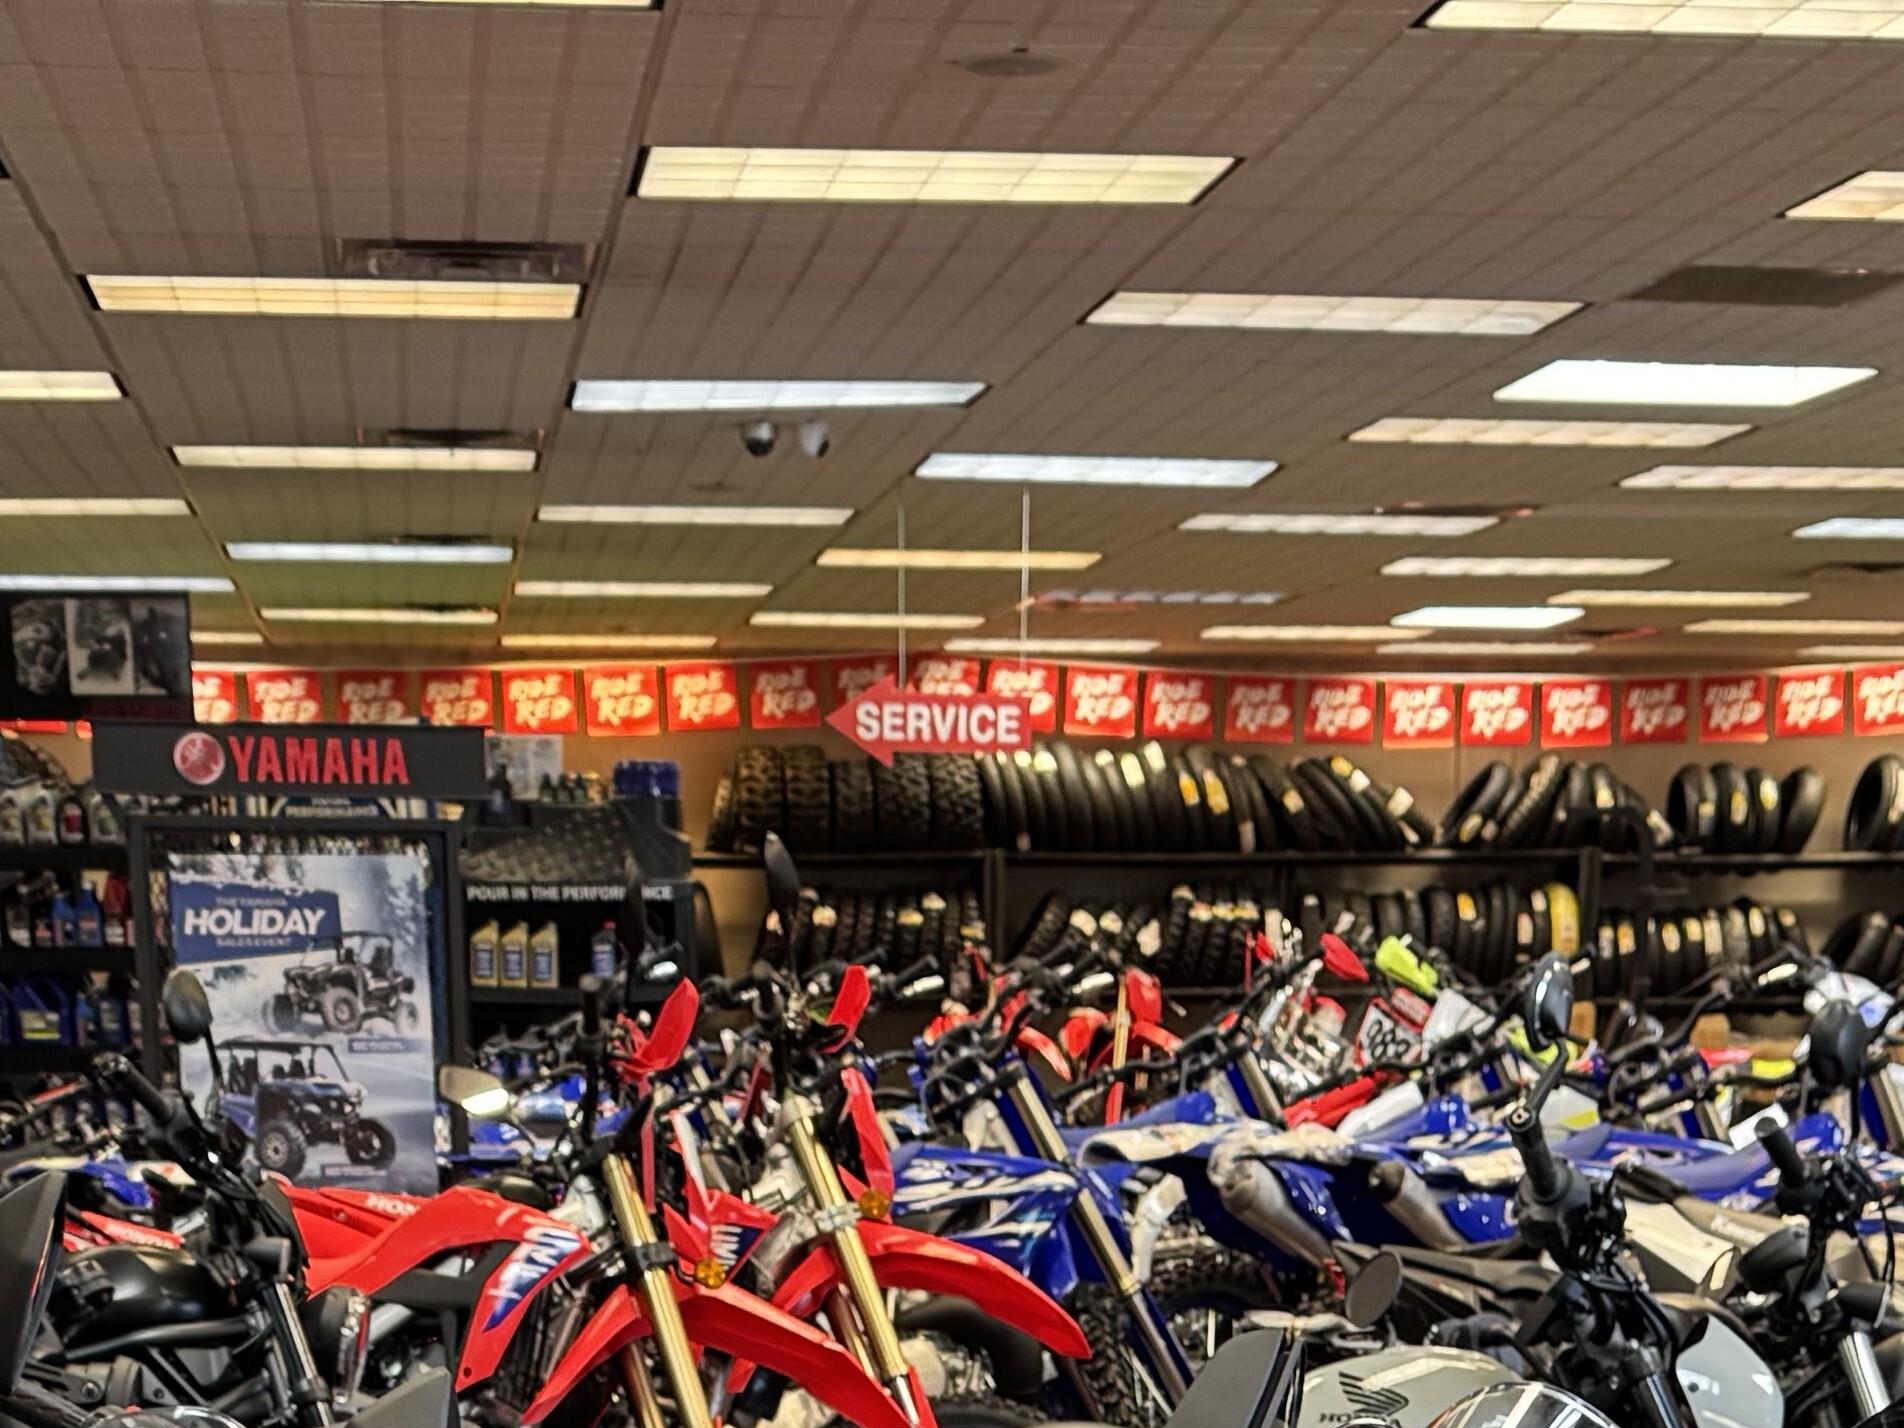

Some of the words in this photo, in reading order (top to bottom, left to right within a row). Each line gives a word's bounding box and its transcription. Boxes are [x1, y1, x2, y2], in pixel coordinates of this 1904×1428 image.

[256, 678, 309, 701] RIDE
[343, 678, 395, 702] RIDE
[426, 676, 480, 702] RIDE
[509, 673, 563, 702] RIDE
[591, 672, 644, 700] RIDE
[673, 669, 725, 697] RIDE
[755, 667, 806, 695] RIDE
[991, 668, 1048, 691] RIDE
[262, 699, 320, 724] RED
[349, 700, 405, 725] RED
[432, 699, 490, 725] RED
[515, 696, 572, 729] RED
[597, 694, 654, 726] RED
[679, 691, 736, 724] RED
[761, 688, 817, 719] RED
[855, 701, 1022, 744] SERVICE
[227, 735, 411, 785] YAMAHA
[183, 908, 326, 936] HOLIDAY
